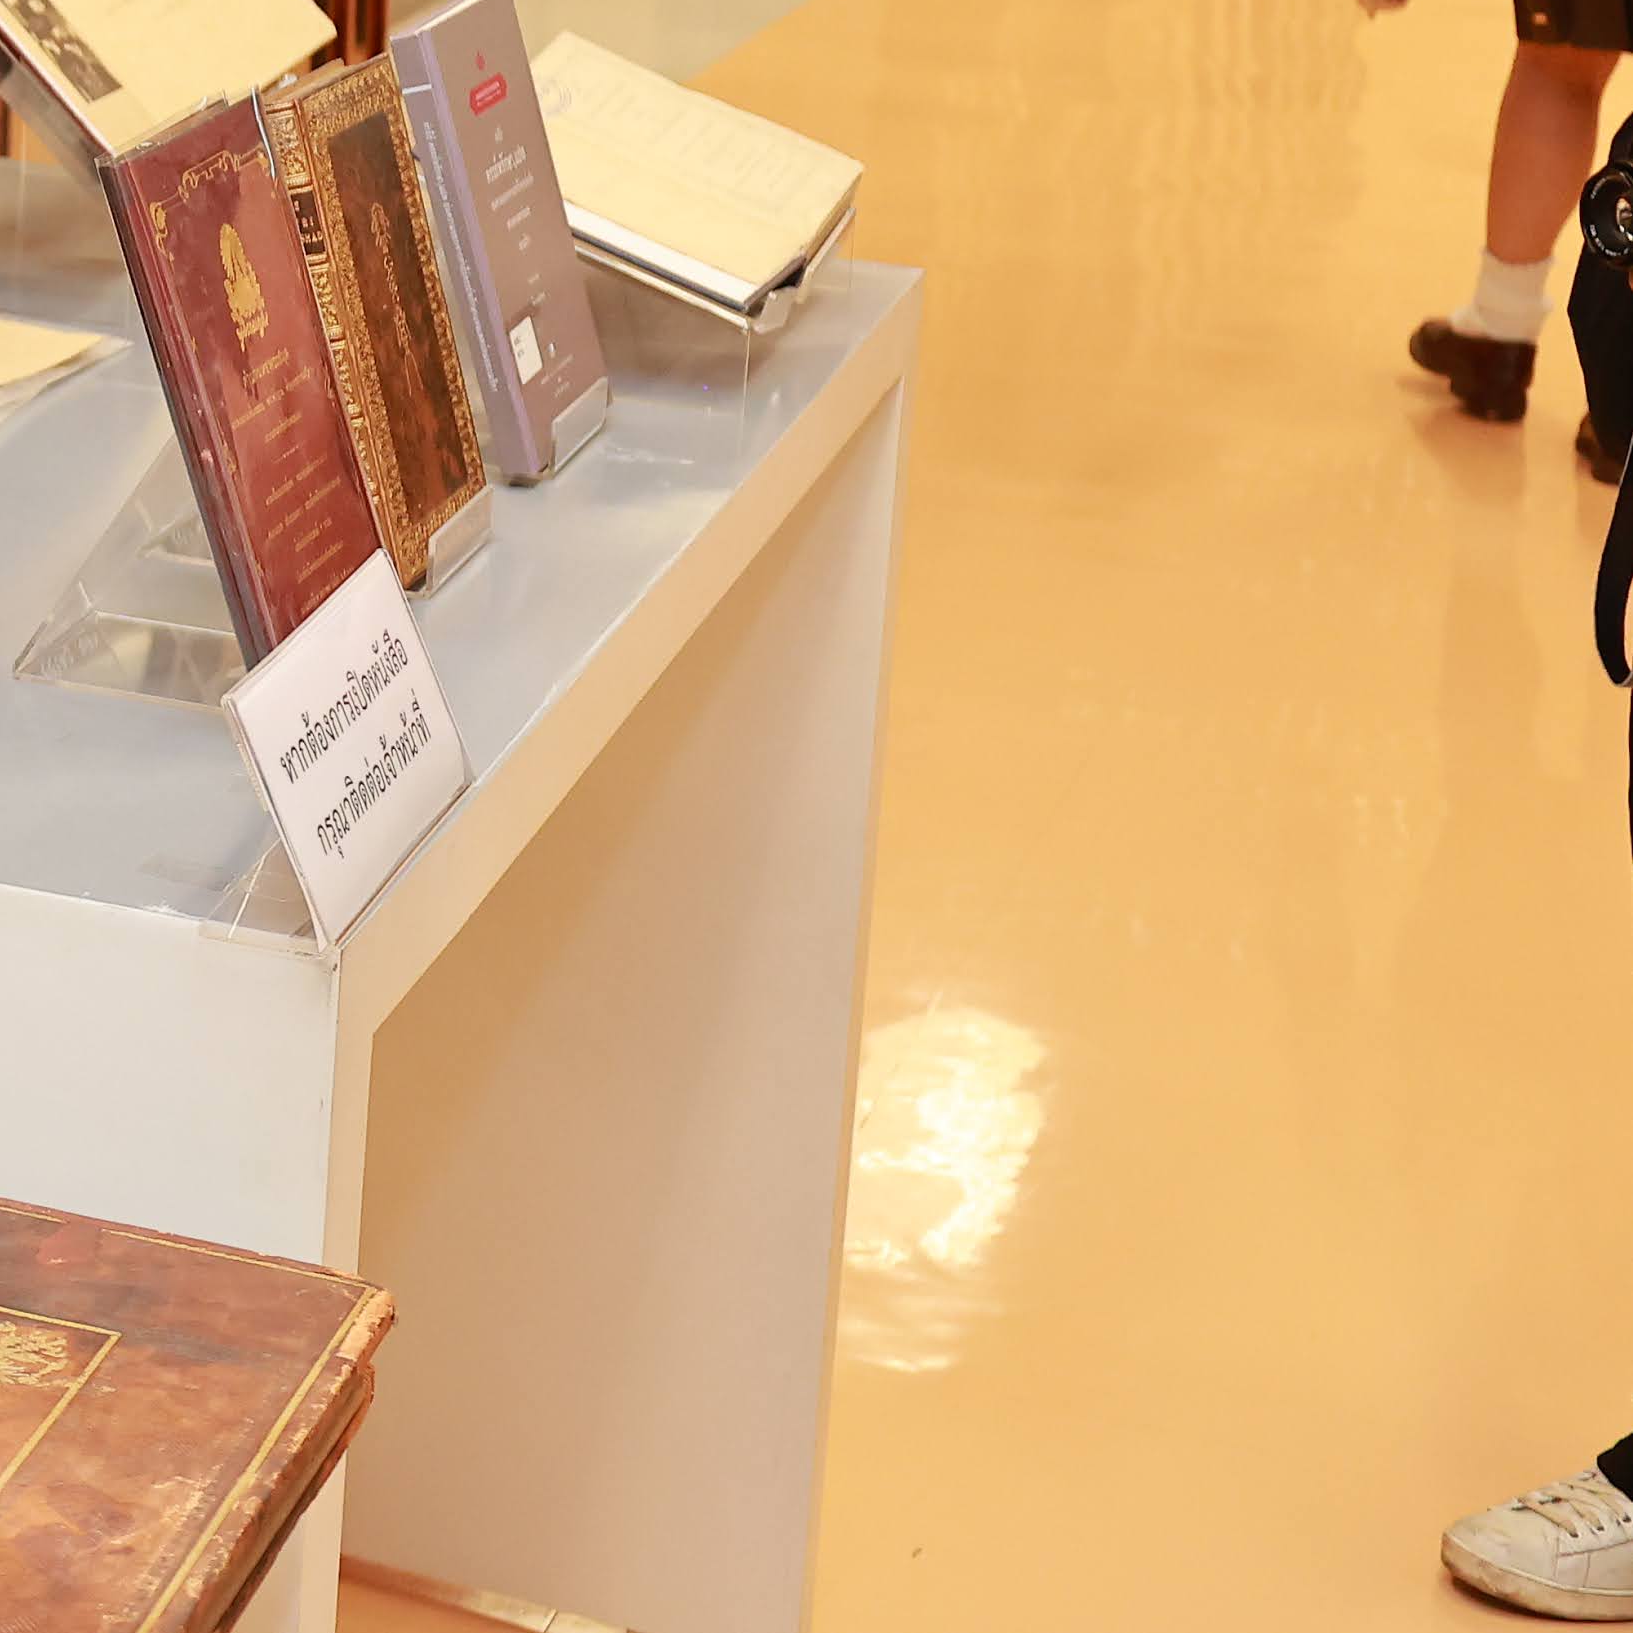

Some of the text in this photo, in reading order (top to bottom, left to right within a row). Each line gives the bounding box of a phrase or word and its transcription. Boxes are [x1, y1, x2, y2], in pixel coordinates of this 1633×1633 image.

[280, 629, 409, 784] หากต้องการเปิดหนังสือ
[317, 689, 432, 859] กรุณาติดต่อเจ้าหน้าที่
